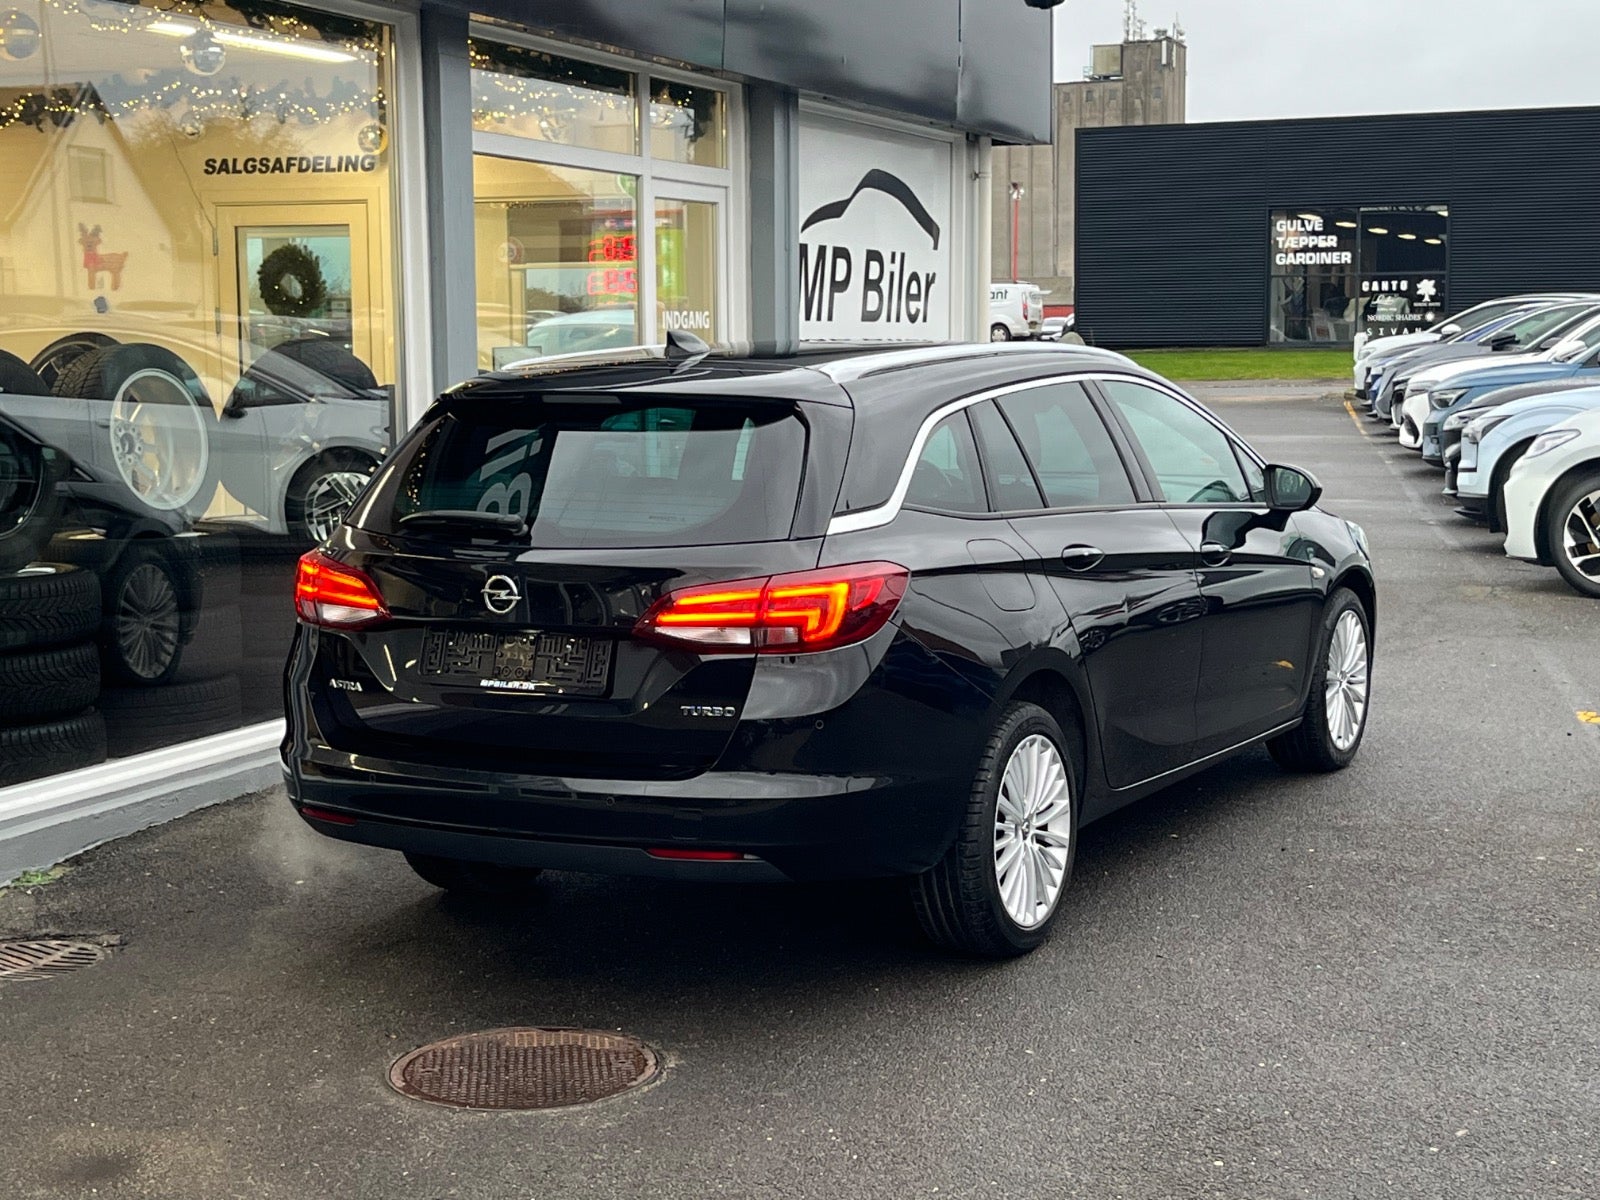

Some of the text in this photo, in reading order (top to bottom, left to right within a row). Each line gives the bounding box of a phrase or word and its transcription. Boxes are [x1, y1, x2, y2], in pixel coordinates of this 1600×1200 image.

[203, 153, 376, 175] SALGSAFDELING
[1275, 219, 1324, 232] GULVE
[1275, 235, 1338, 249] TÆPPER
[1275, 251, 1352, 265] GARDINER
[799, 243, 936, 324] MP Biler
[1361, 280, 1408, 292] CANTO
[662, 310, 710, 329] INDGANG
[329, 678, 363, 691] ASTRA
[680, 705, 736, 717] TURBO
